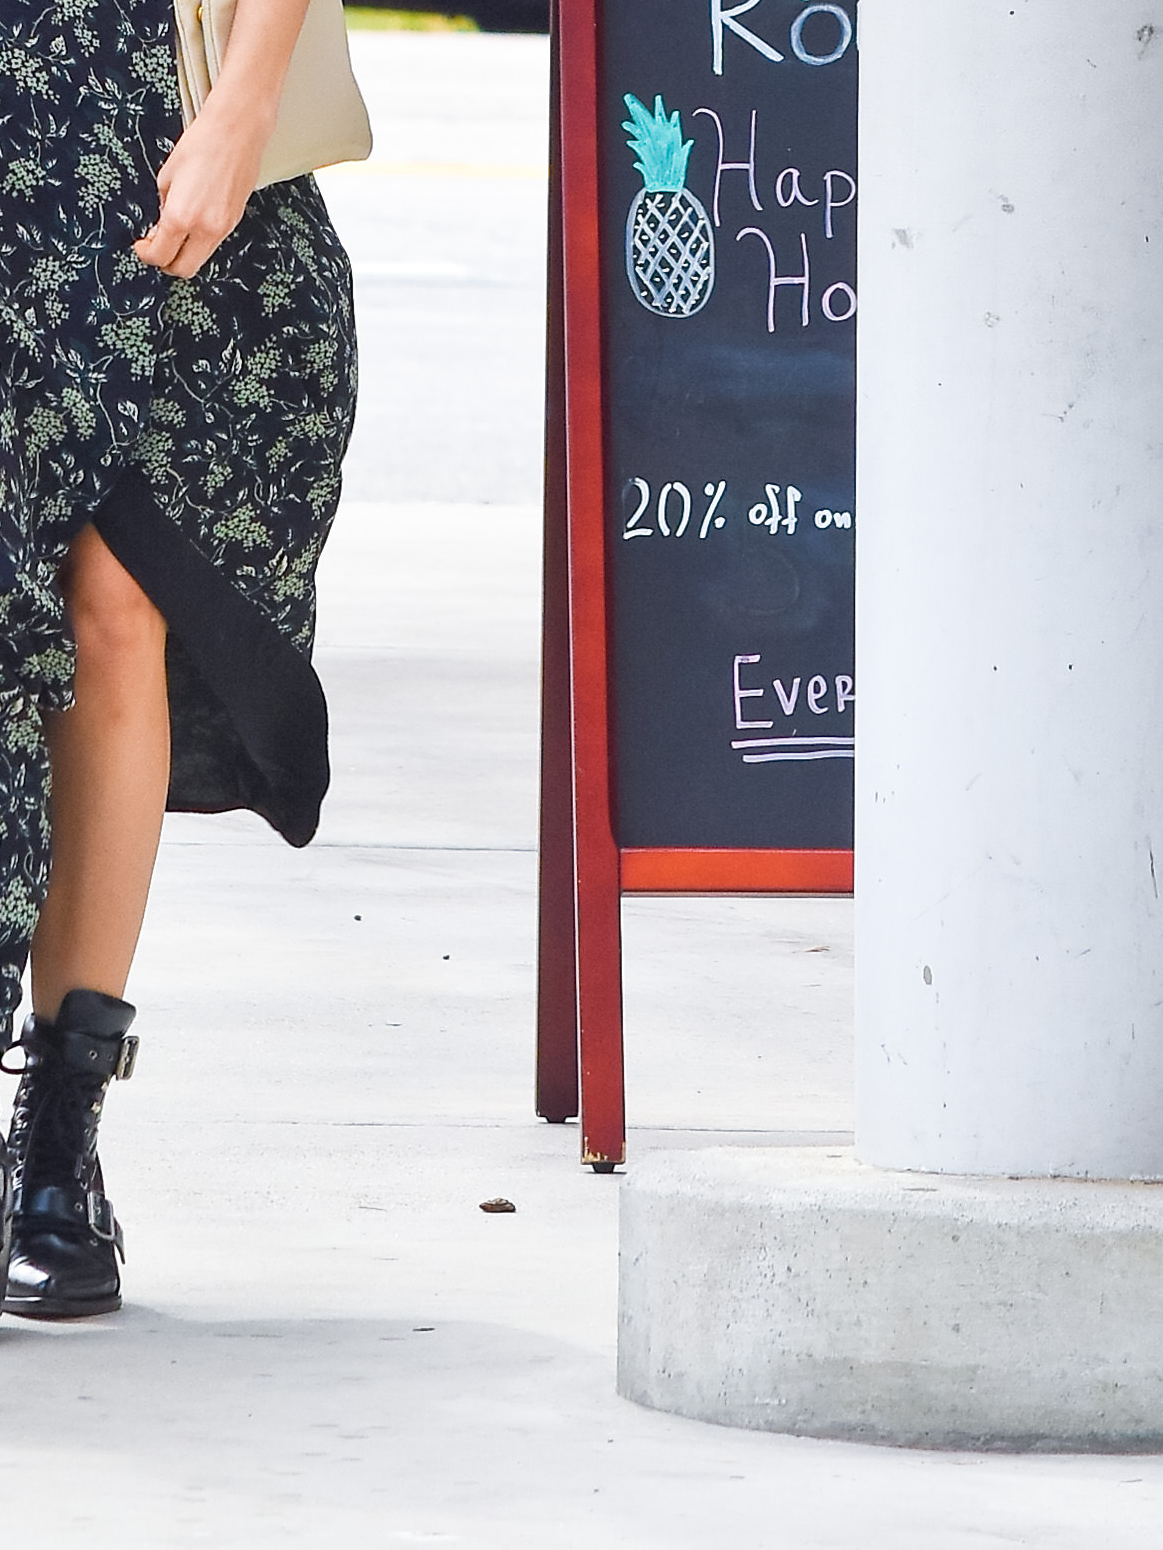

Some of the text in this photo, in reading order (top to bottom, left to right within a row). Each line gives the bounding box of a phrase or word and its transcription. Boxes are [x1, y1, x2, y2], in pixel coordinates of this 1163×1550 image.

[692, 108, 856, 238] Hap
[736, 226, 857, 333] Ho
[622, 476, 852, 539] 20% off on
